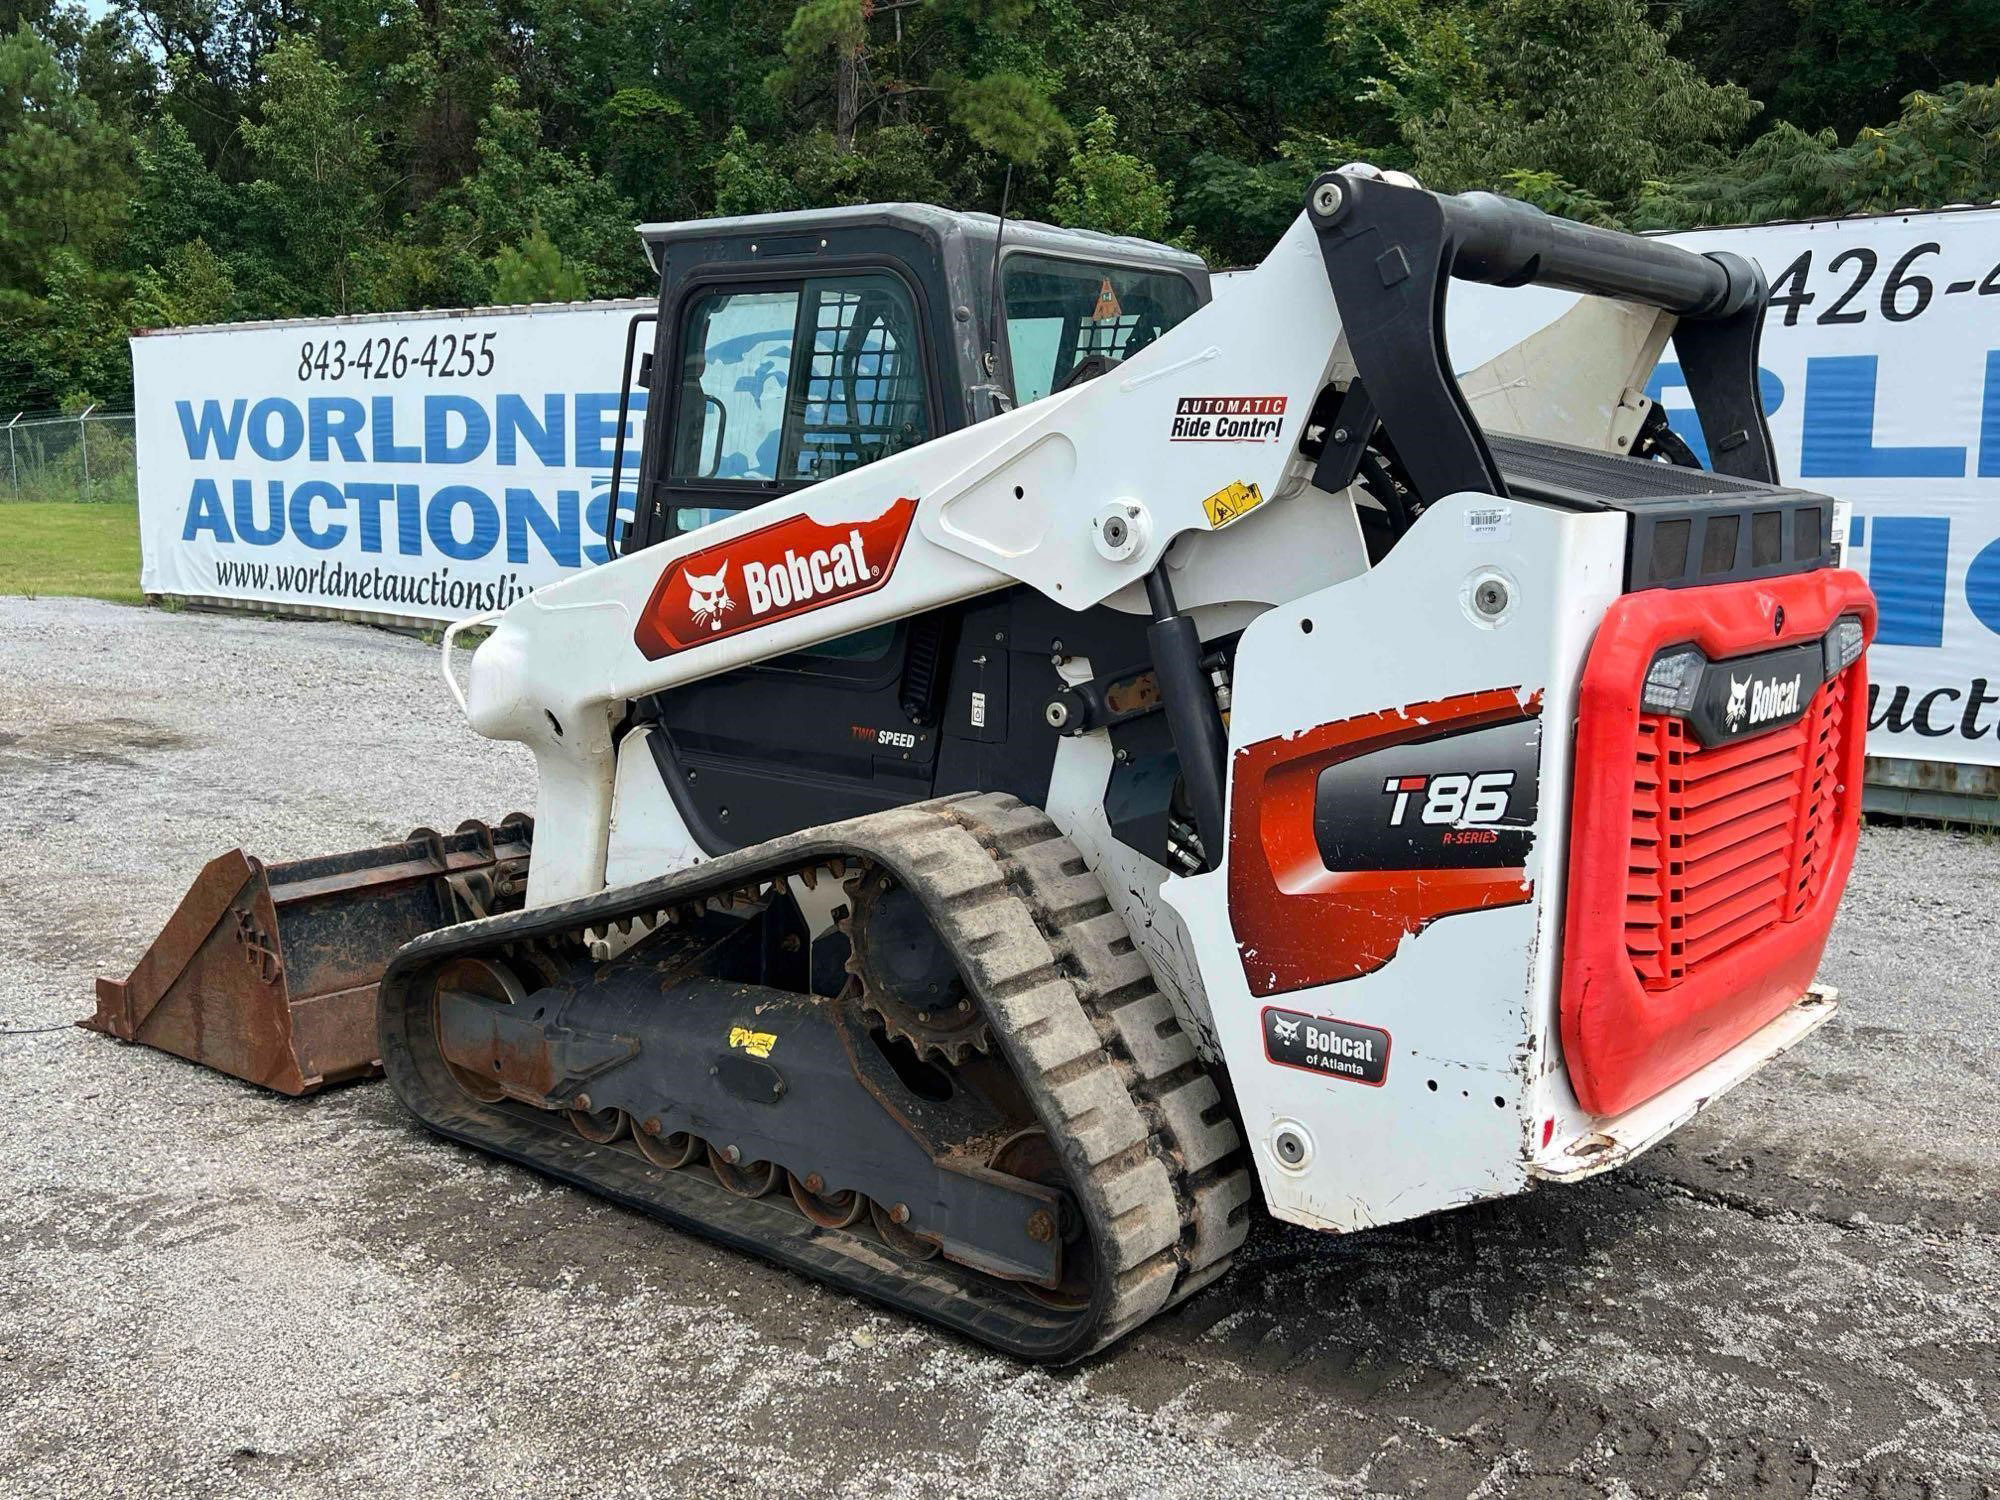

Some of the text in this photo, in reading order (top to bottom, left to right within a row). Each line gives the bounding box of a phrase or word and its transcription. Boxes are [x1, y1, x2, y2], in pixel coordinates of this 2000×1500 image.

[297, 332, 498, 382] 843-426-4255
[1180, 400, 1283, 414] AUTOMATIC
[175, 392, 650, 469] WORLDNE
[1171, 416, 1284, 438] Ride Control
[1748, 672, 1801, 724] Bobcat
[1866, 678, 2000, 741] uct
[851, 726, 916, 749] TWO SPEED
[1385, 772, 1515, 826] T86
[1443, 831, 1498, 845] R-SERIES
[1305, 1025, 1373, 1062] Bobcat
[1305, 1053, 1365, 1076] of Atlanta
